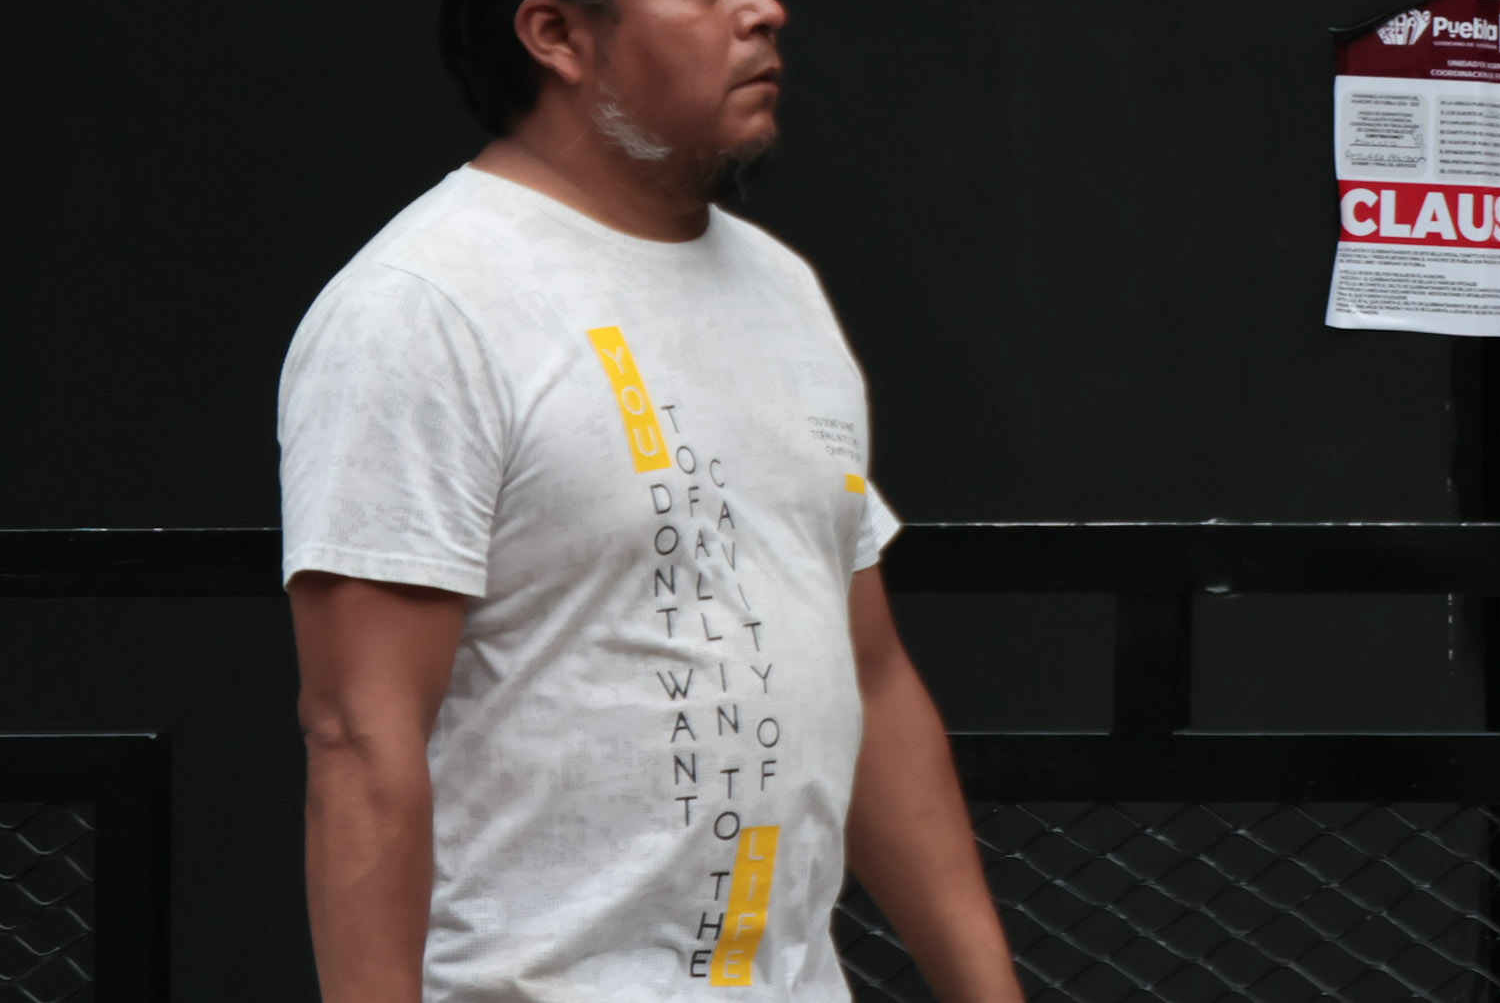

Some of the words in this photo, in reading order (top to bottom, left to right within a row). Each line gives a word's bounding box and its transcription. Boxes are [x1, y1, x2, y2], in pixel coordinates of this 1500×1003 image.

[602, 347, 661, 458] YOU
[651, 483, 680, 639] DONT
[656, 668, 698, 828] WANT
[690, 871, 731, 979] THE
[721, 829, 766, 981] LIFE
